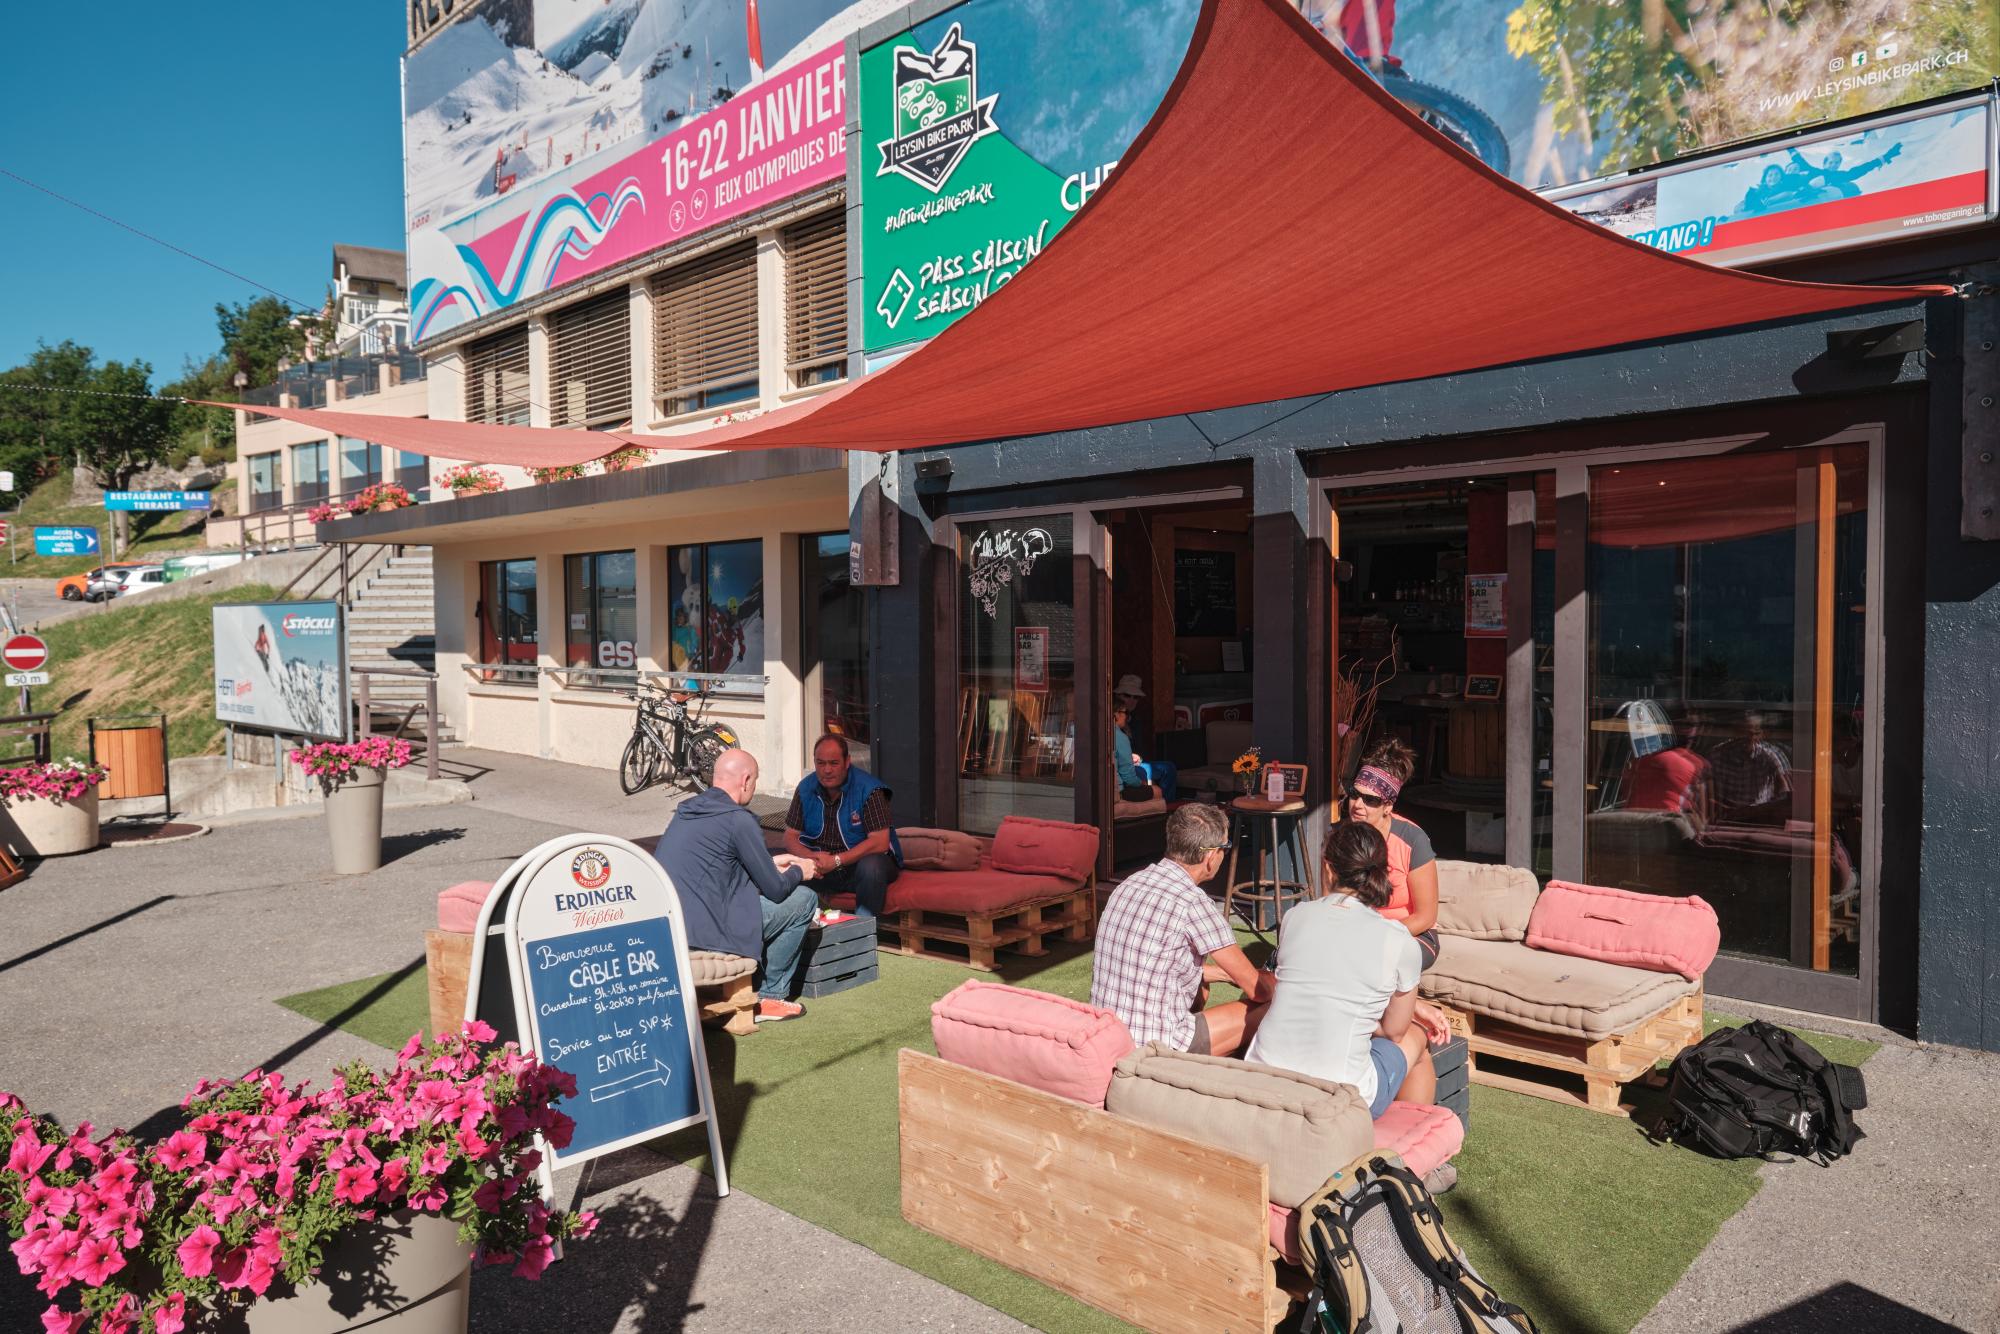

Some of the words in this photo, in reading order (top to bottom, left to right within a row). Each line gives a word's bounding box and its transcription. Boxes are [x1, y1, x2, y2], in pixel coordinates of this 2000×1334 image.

[1759, 48, 1969, 112] WWW.LEYSINBIKEPARK.CH
[895, 136, 925, 160] LEYSIN
[927, 127, 947, 148] BIKE
[947, 116, 974, 140] PARK
[661, 118, 730, 197] 16-22
[714, 175, 742, 209] JEUX
[745, 136, 824, 195] OLYMPIQUES
[884, 182, 995, 234] #NATURALBIKEPARK
[1903, 203, 1985, 227] www.tobogganing.ch
[918, 256, 965, 290] PASS
[968, 219, 1049, 275] SAISON
[913, 268, 994, 320] SEASON
[110, 492, 173, 500] RESTAURANT
[184, 492, 204, 500] BAR
[134, 501, 180, 509] TERRASSE
[598, 640, 638, 667] es
[13, 674, 27, 684] 50
[30, 675, 41, 683] m
[573, 851, 608, 869] ERDINGER
[555, 885, 637, 912] ERDINGER
[571, 907, 624, 929] Weißbier
[536, 942, 616, 970] Bienvenue
[627, 937, 645, 946] au
[569, 958, 622, 988] CÂBLE
[627, 950, 660, 976] BAR
[594, 995, 635, 1014] 9h-20h30
[595, 982, 627, 1001] 9h-18h
[640, 975, 669, 988] semaine
[548, 1038, 592, 1062] Service
[597, 1034, 613, 1042] au
[613, 1020, 633, 1038] bar
[639, 1015, 659, 1034] SVP
[597, 1040, 648, 1073] ENTRÉE
